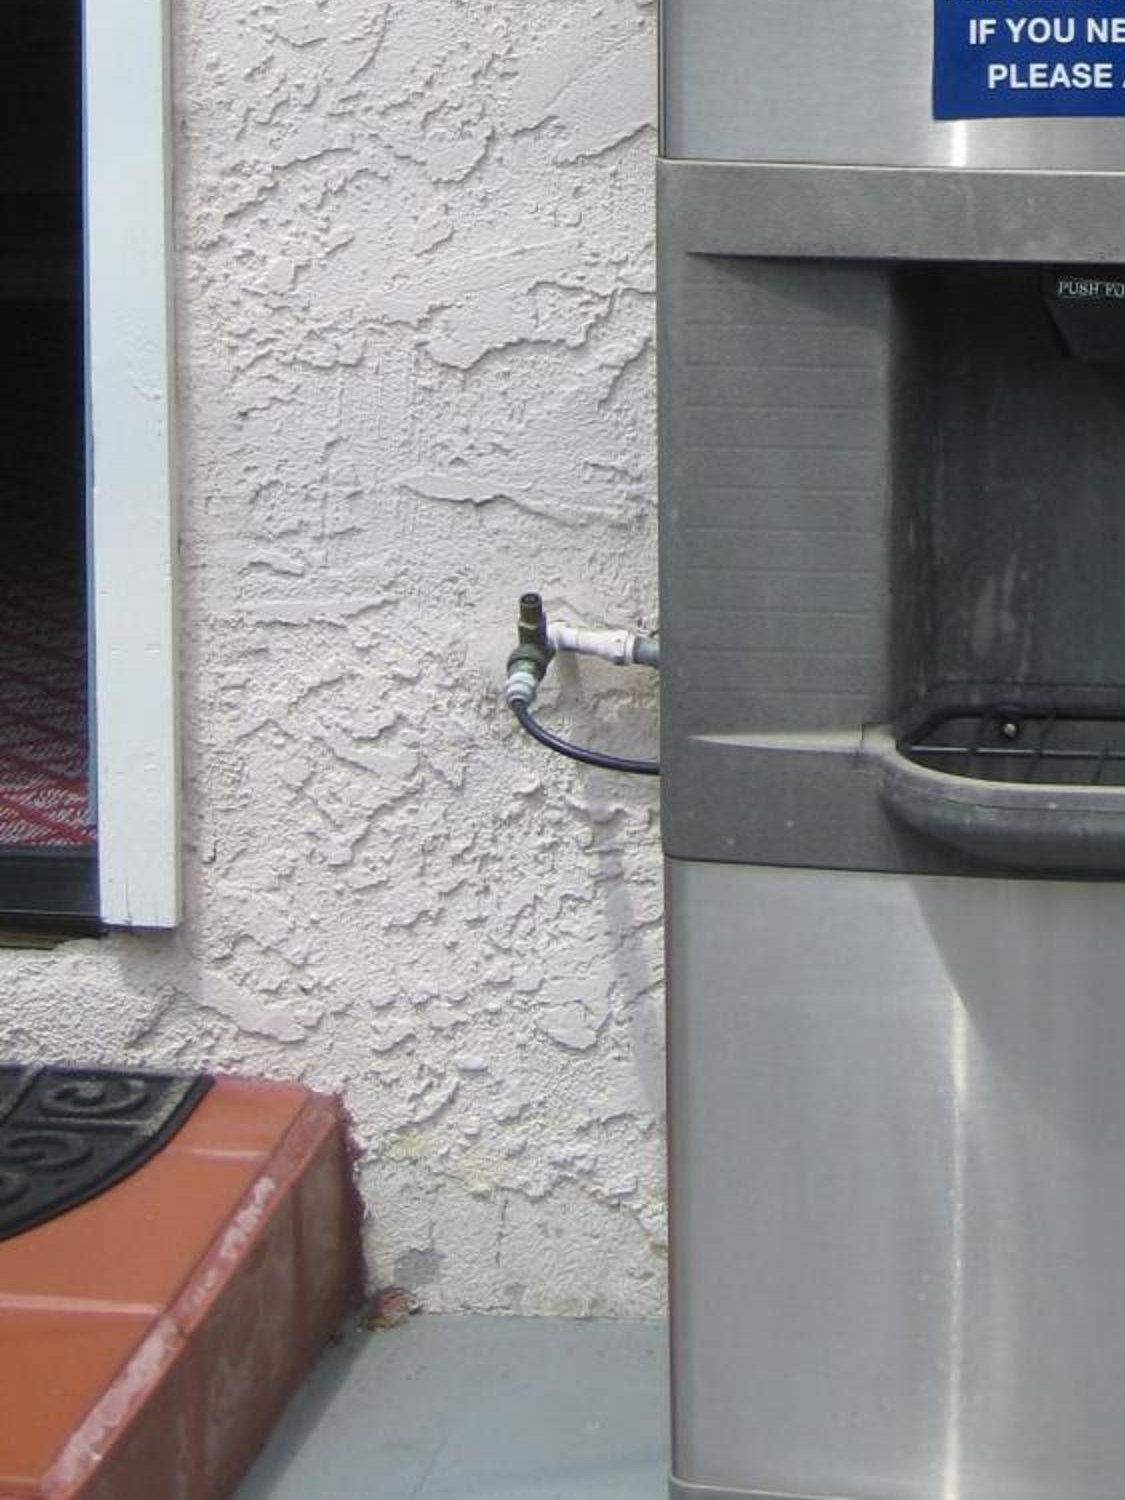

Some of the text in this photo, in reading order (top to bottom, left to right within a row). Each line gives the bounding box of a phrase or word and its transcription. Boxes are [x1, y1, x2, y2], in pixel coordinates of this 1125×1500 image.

[969, 19, 996, 44] IF
[1006, 18, 1074, 43] YOU
[988, 63, 1112, 89] PLEASE
[1058, 280, 1099, 296] PUSH
